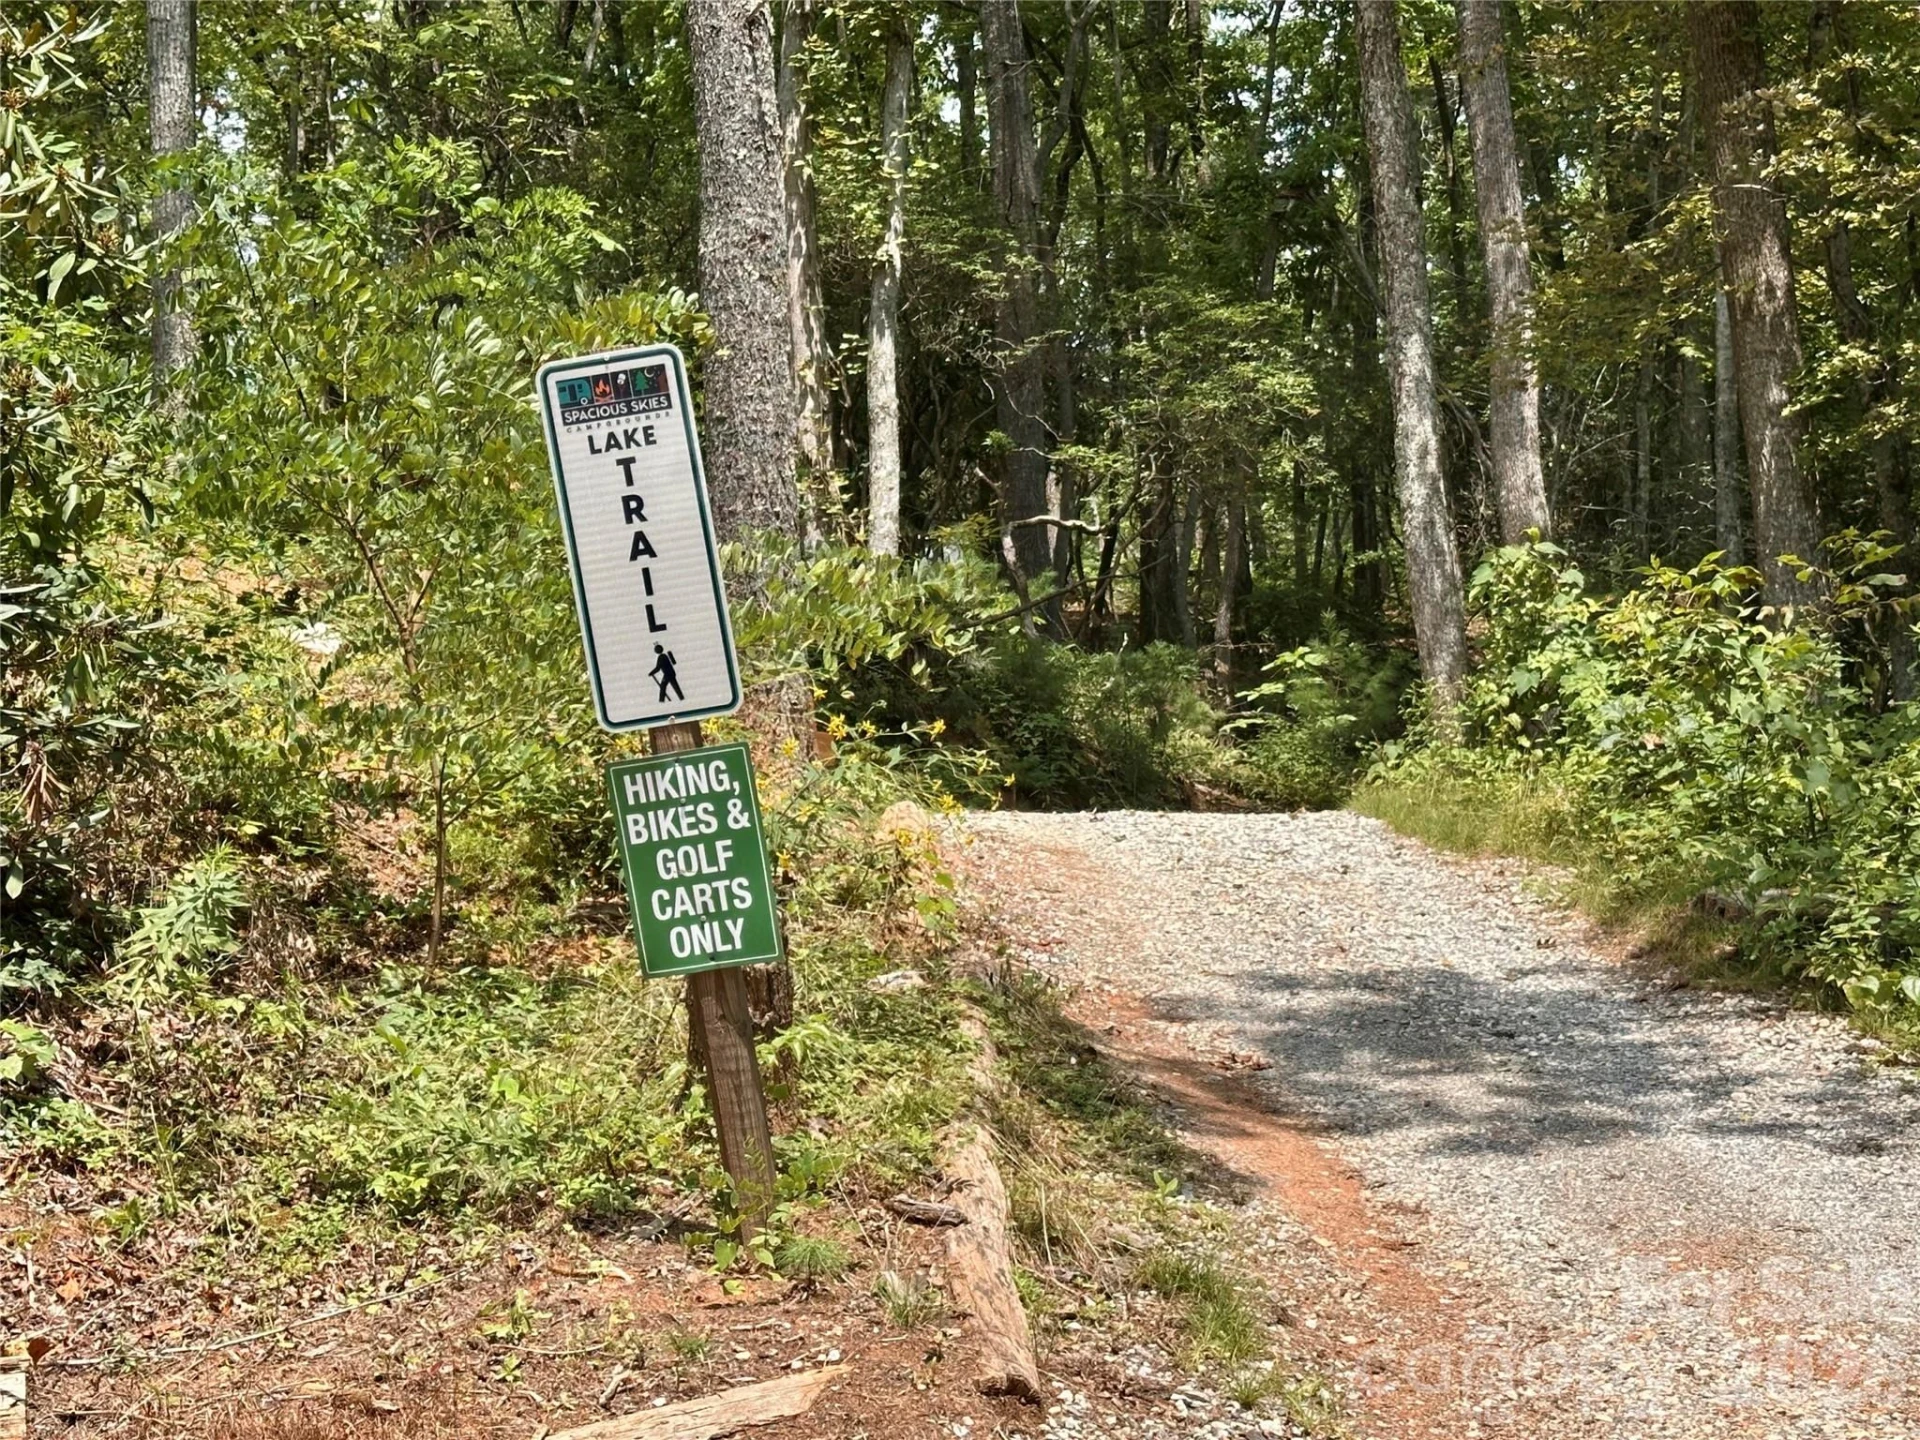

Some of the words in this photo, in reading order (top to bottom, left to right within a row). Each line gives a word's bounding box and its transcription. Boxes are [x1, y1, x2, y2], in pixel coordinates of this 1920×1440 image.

[563, 402, 628, 424] SPACIOUS
[631, 396, 669, 413] SKIES
[566, 411, 671, 434] CAMPGROUNDS
[587, 425, 658, 455] LAKE
[615, 456, 667, 633] TRAIL
[623, 760, 740, 806] HIKING,
[626, 802, 718, 845] BIKES
[727, 798, 751, 830] &
[656, 839, 734, 880] GOLF
[651, 877, 753, 921] CARTS
[669, 917, 745, 958] ONLY
